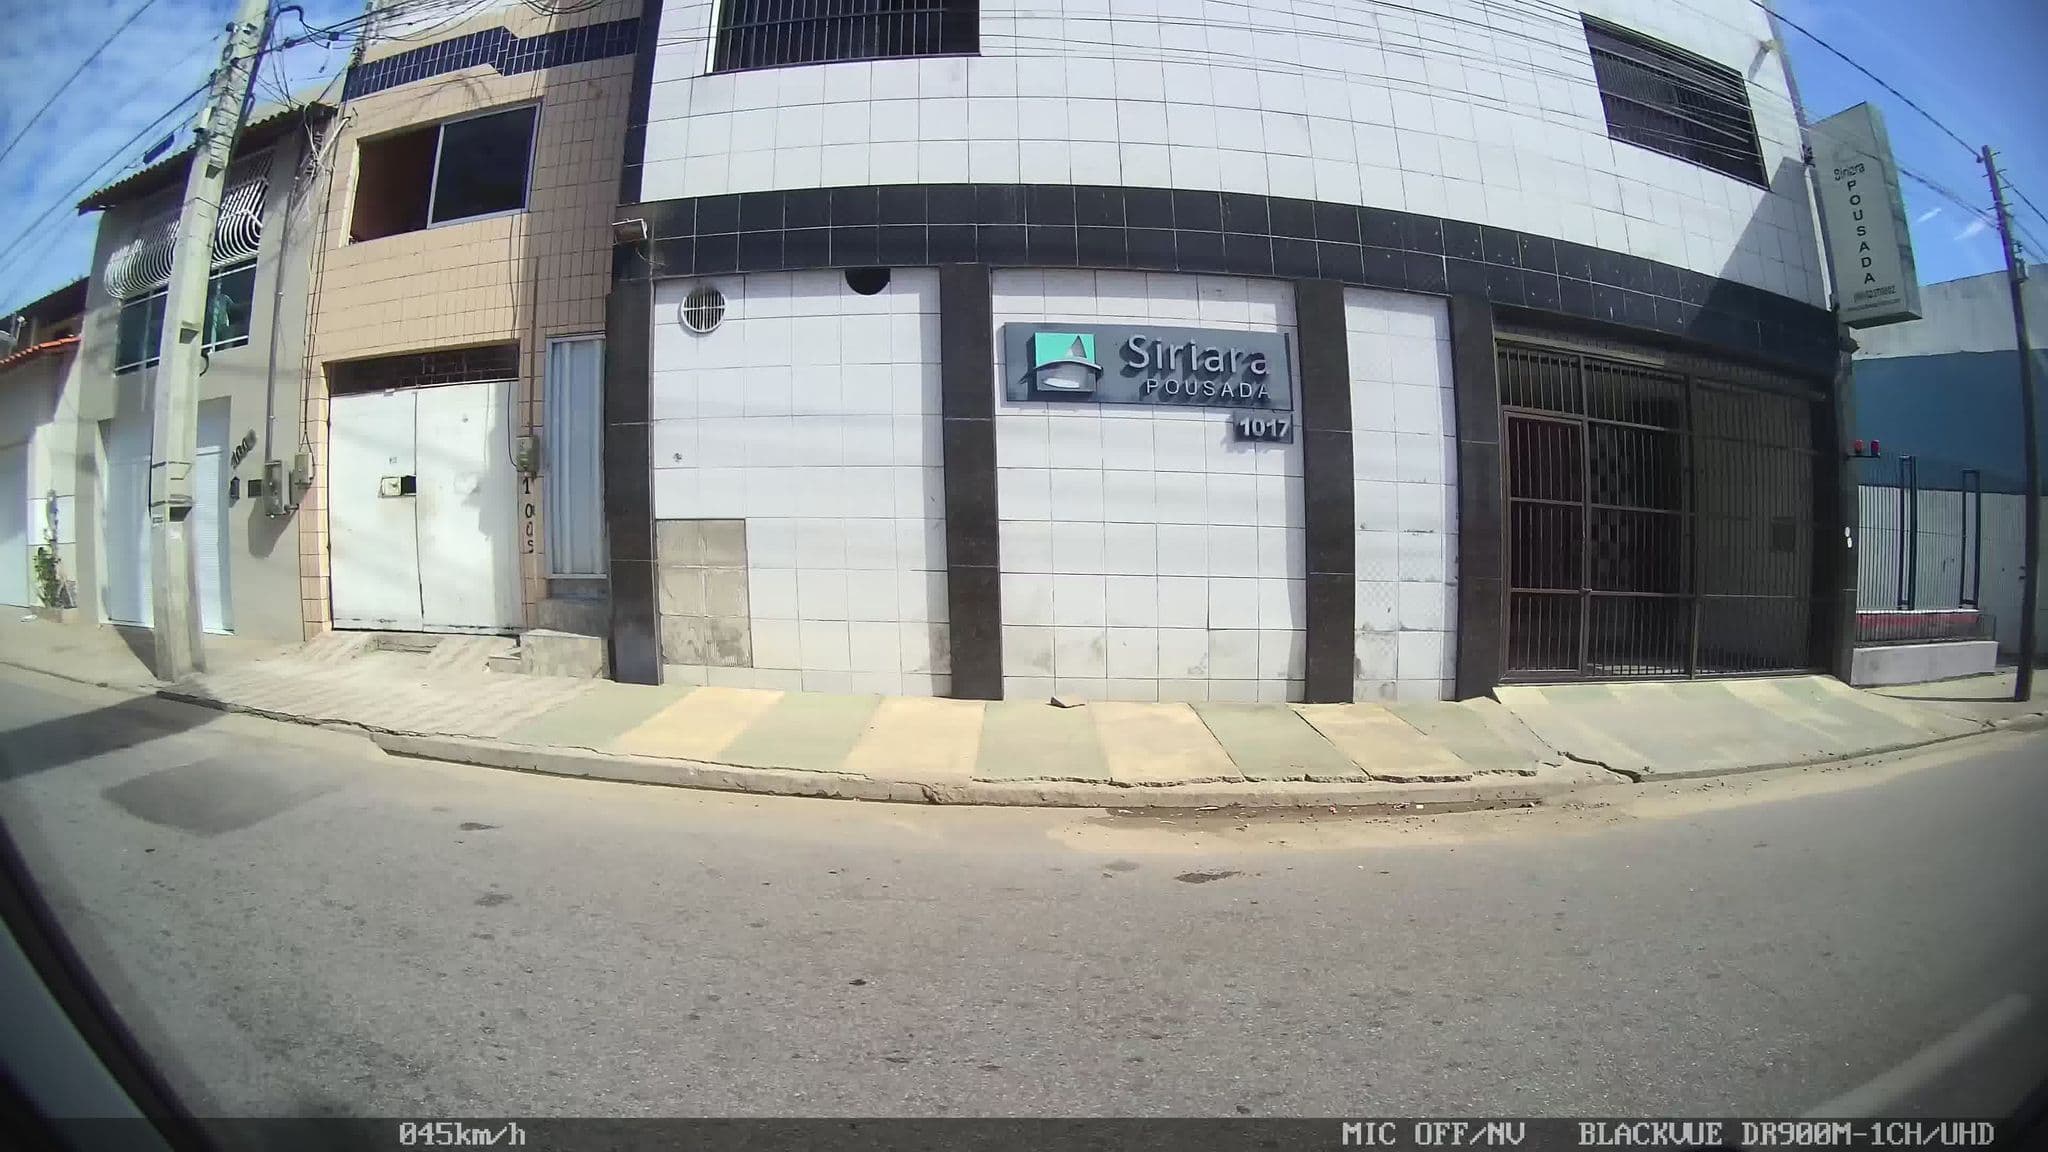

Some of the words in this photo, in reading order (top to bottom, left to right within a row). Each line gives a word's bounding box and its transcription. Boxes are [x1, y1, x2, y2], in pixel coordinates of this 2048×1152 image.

[1847, 180, 1876, 285] POUSADA
[1127, 334, 1270, 376] Siriara
[1146, 378, 1272, 399] POUSADA
[1239, 417, 1290, 438] 1017
